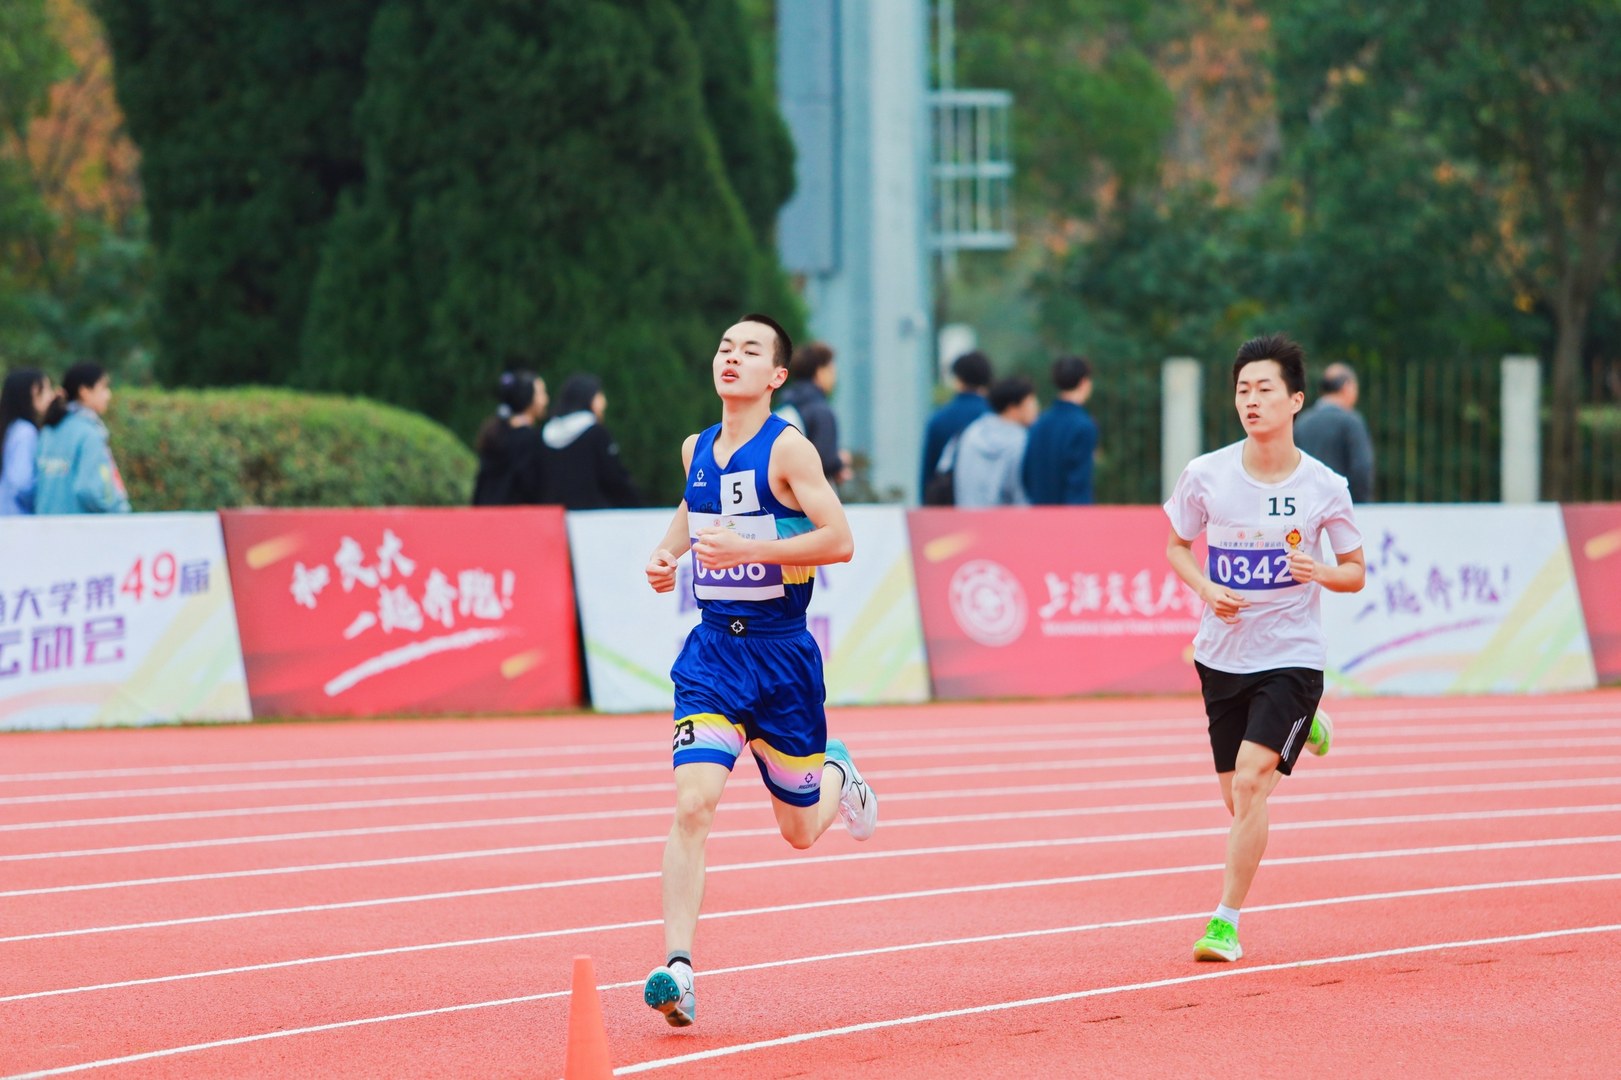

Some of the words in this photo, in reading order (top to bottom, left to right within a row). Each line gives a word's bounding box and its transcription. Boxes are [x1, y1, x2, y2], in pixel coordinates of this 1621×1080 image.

[732, 481, 743, 504] 5
[1268, 497, 1296, 516] 15
[1217, 554, 1293, 584] 0342
[0, 551, 210, 622] 大学第49届
